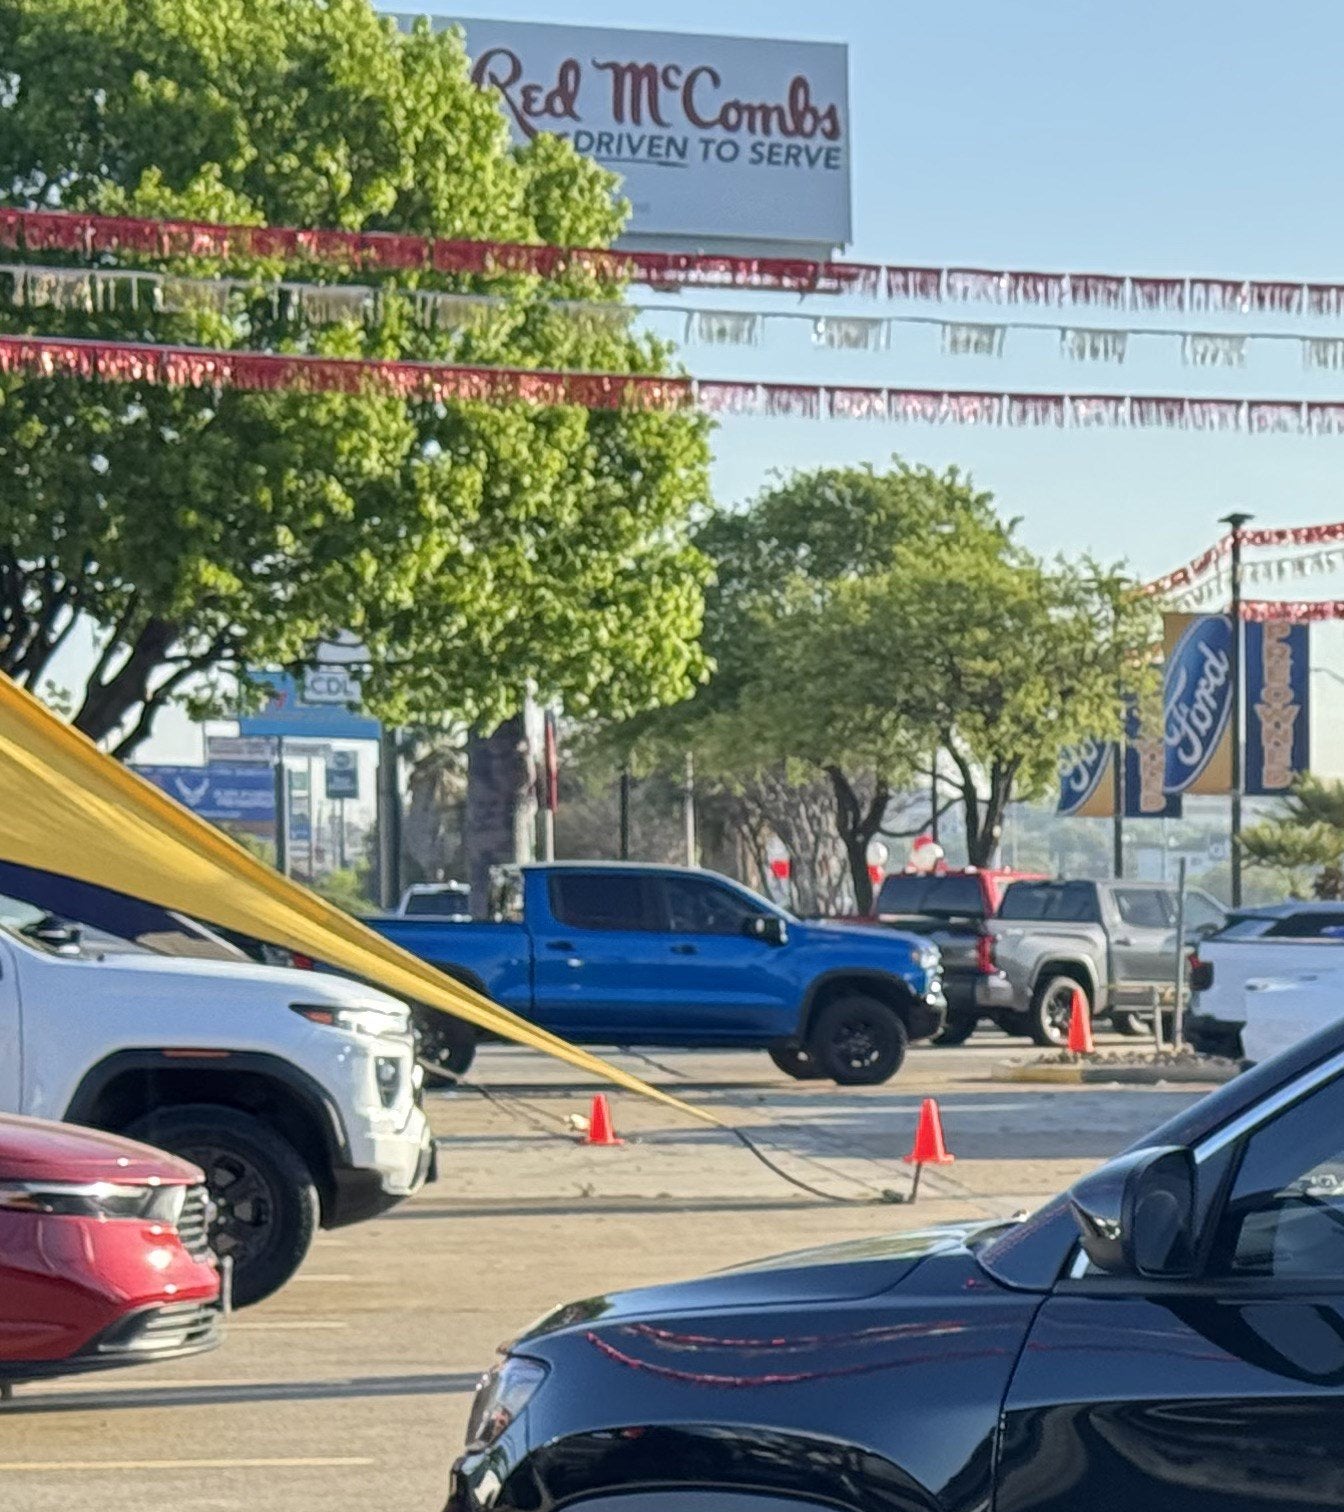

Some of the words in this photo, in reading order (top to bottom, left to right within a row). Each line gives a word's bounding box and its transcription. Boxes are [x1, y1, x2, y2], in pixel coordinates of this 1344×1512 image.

[471, 47, 582, 141] Red
[591, 56, 842, 141] McCombs
[573, 129, 689, 161] DRIVEN
[697, 137, 740, 164] TO
[748, 140, 842, 170] SERVE
[1164, 640, 1230, 767] Ford
